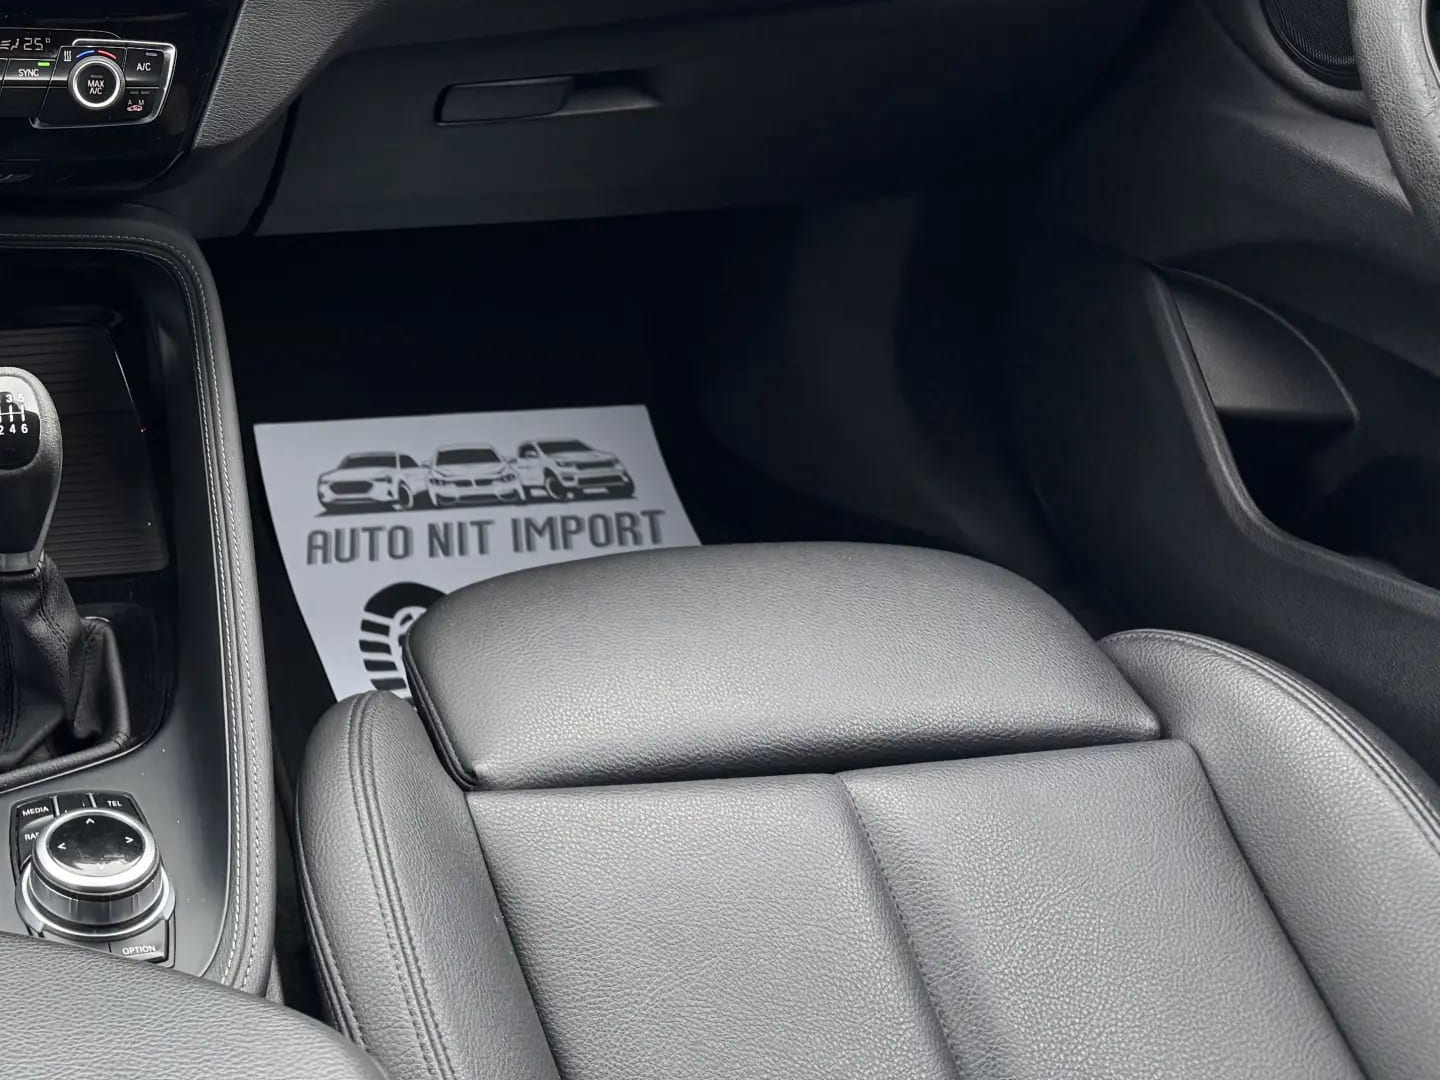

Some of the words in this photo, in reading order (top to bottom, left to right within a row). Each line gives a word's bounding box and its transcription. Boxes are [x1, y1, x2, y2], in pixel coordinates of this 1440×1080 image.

[136, 62, 151, 71] A/C
[18, 68, 39, 77] SYNC
[87, 79, 105, 88] MAX
[89, 87, 103, 95] A/C
[5, 394, 13, 404] 3
[9, 424, 16, 434] 4
[21, 423, 29, 434] 6
[306, 524, 414, 565] AUTO
[427, 519, 494, 559] NIT
[511, 509, 666, 554] IMPORT
[106, 800, 122, 808] TEL
[22, 806, 49, 817] MEDIA
[122, 944, 157, 956] OPTION
